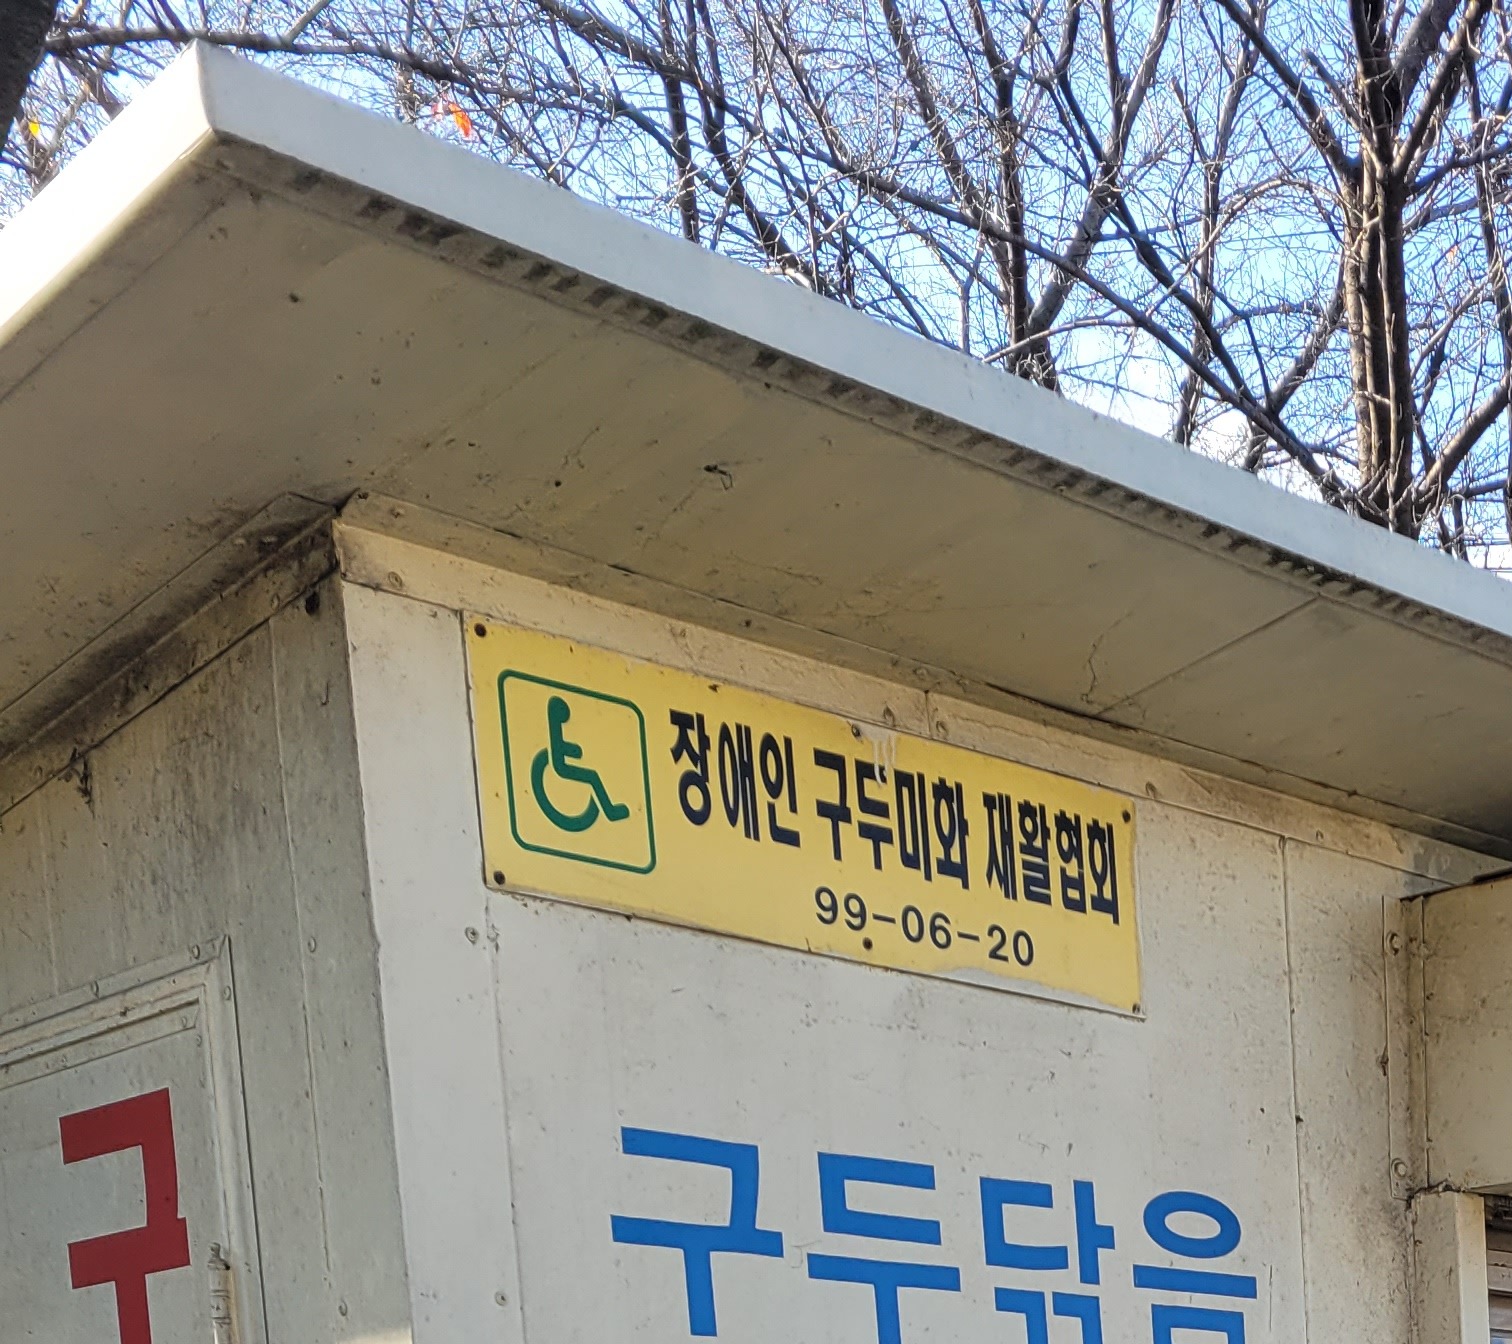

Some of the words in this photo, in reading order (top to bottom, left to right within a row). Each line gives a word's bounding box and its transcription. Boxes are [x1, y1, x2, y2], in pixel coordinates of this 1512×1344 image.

[668, 708, 801, 849] 장애인
[813, 748, 970, 890] 구두미화
[982, 791, 1120, 925] 재활협회
[815, 886, 1035, 967] 99-06-20
